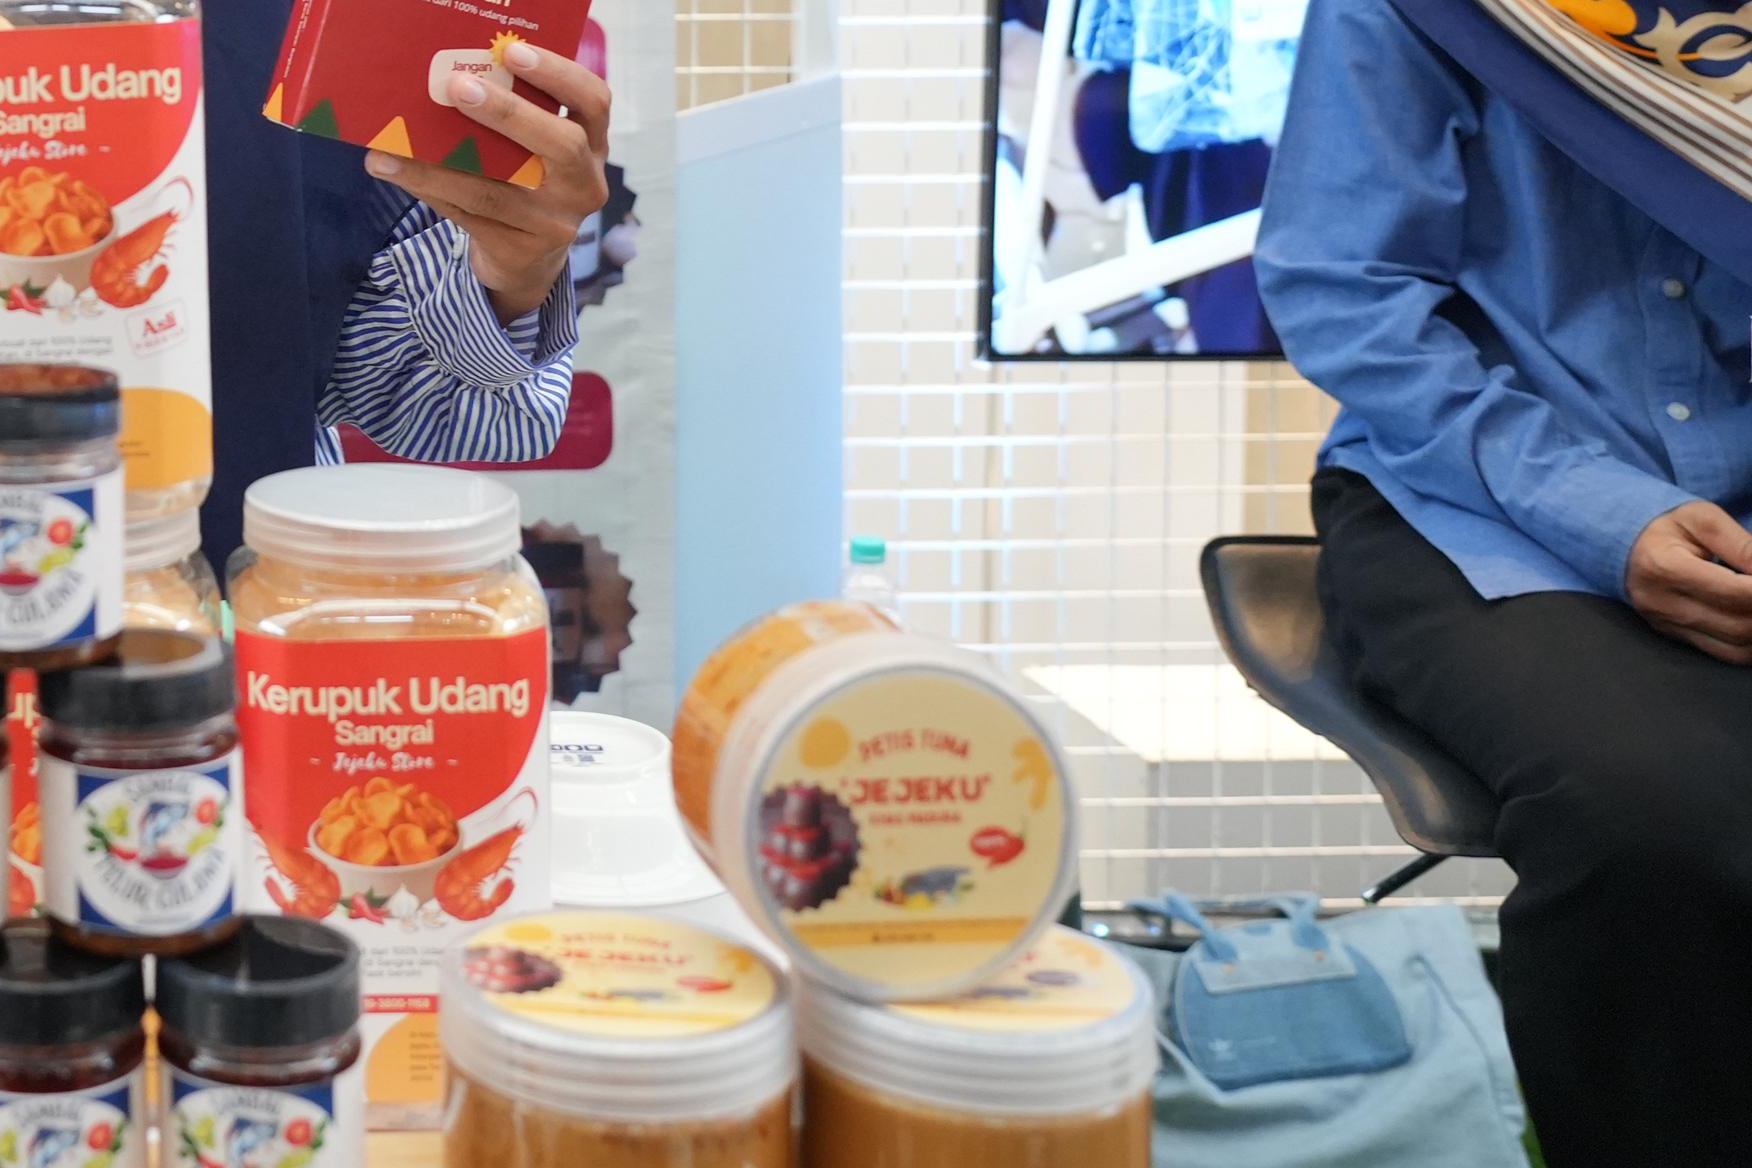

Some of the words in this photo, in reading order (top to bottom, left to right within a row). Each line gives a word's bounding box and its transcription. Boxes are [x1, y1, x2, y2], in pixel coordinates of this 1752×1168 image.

[453, 0, 478, 16] 100%
[478, 7, 509, 27] udang
[508, 14, 540, 32] pilihan
[451, 59, 493, 75] Jangan
[59, 63, 183, 105] Udang
[249, 670, 402, 722] Kerupuk
[408, 676, 530, 718] Udang
[335, 718, 435, 750] Sangrai
